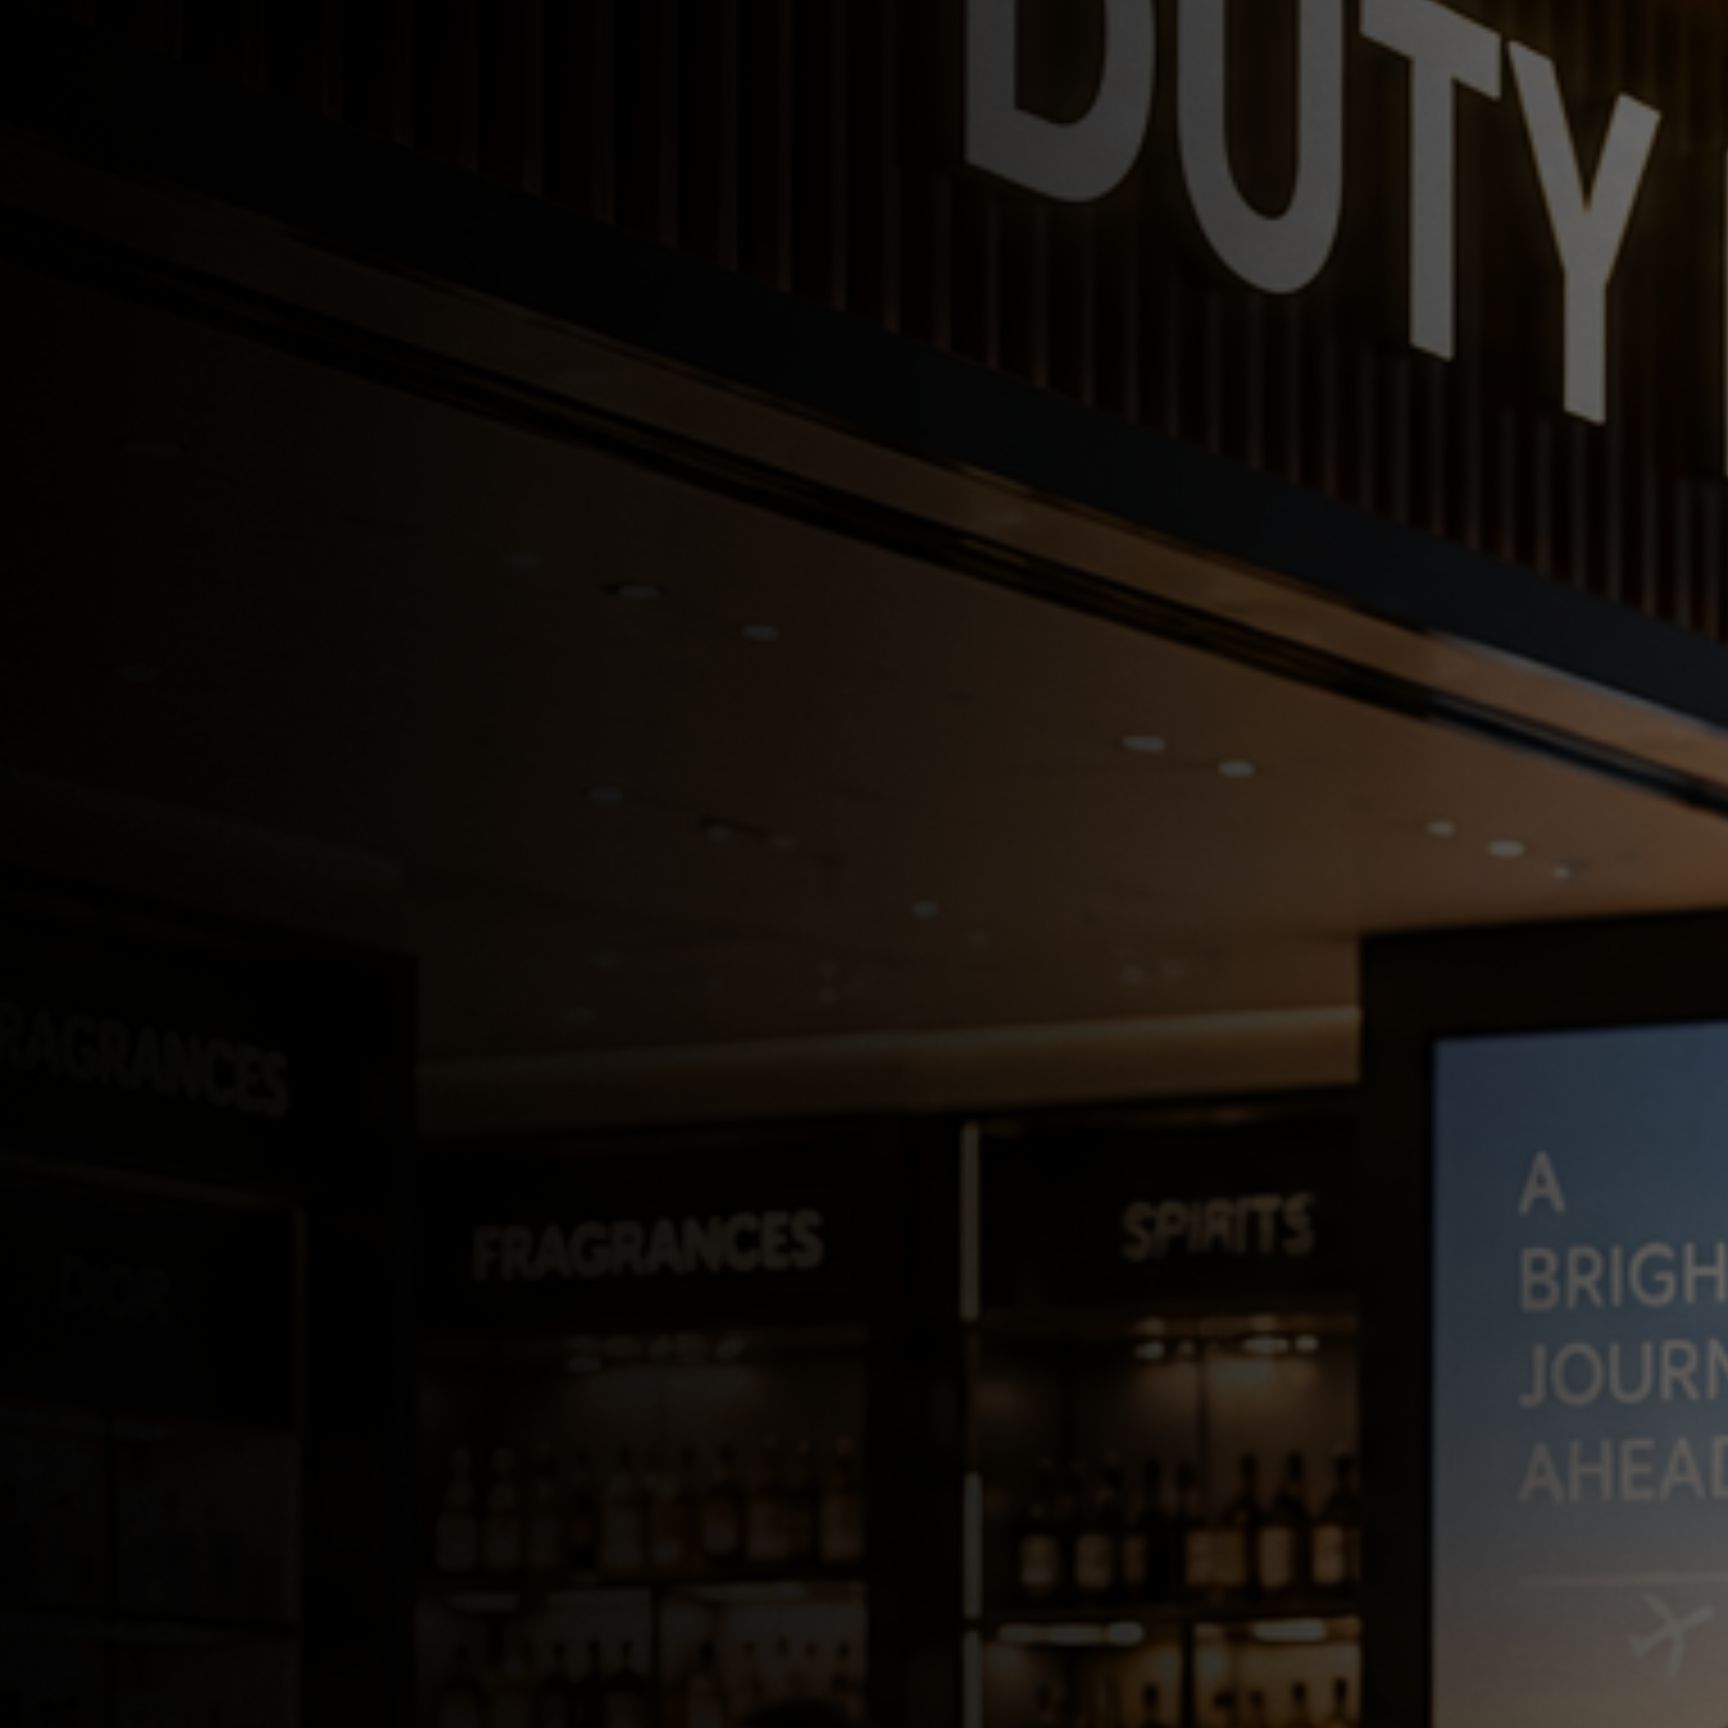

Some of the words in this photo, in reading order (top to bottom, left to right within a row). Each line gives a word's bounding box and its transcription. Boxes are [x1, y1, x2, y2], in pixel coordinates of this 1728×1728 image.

[1517, 1150, 1567, 1215] A
[471, 1206, 827, 1286] FRAGRANCES
[1120, 1191, 1318, 1264] SPIRITS
